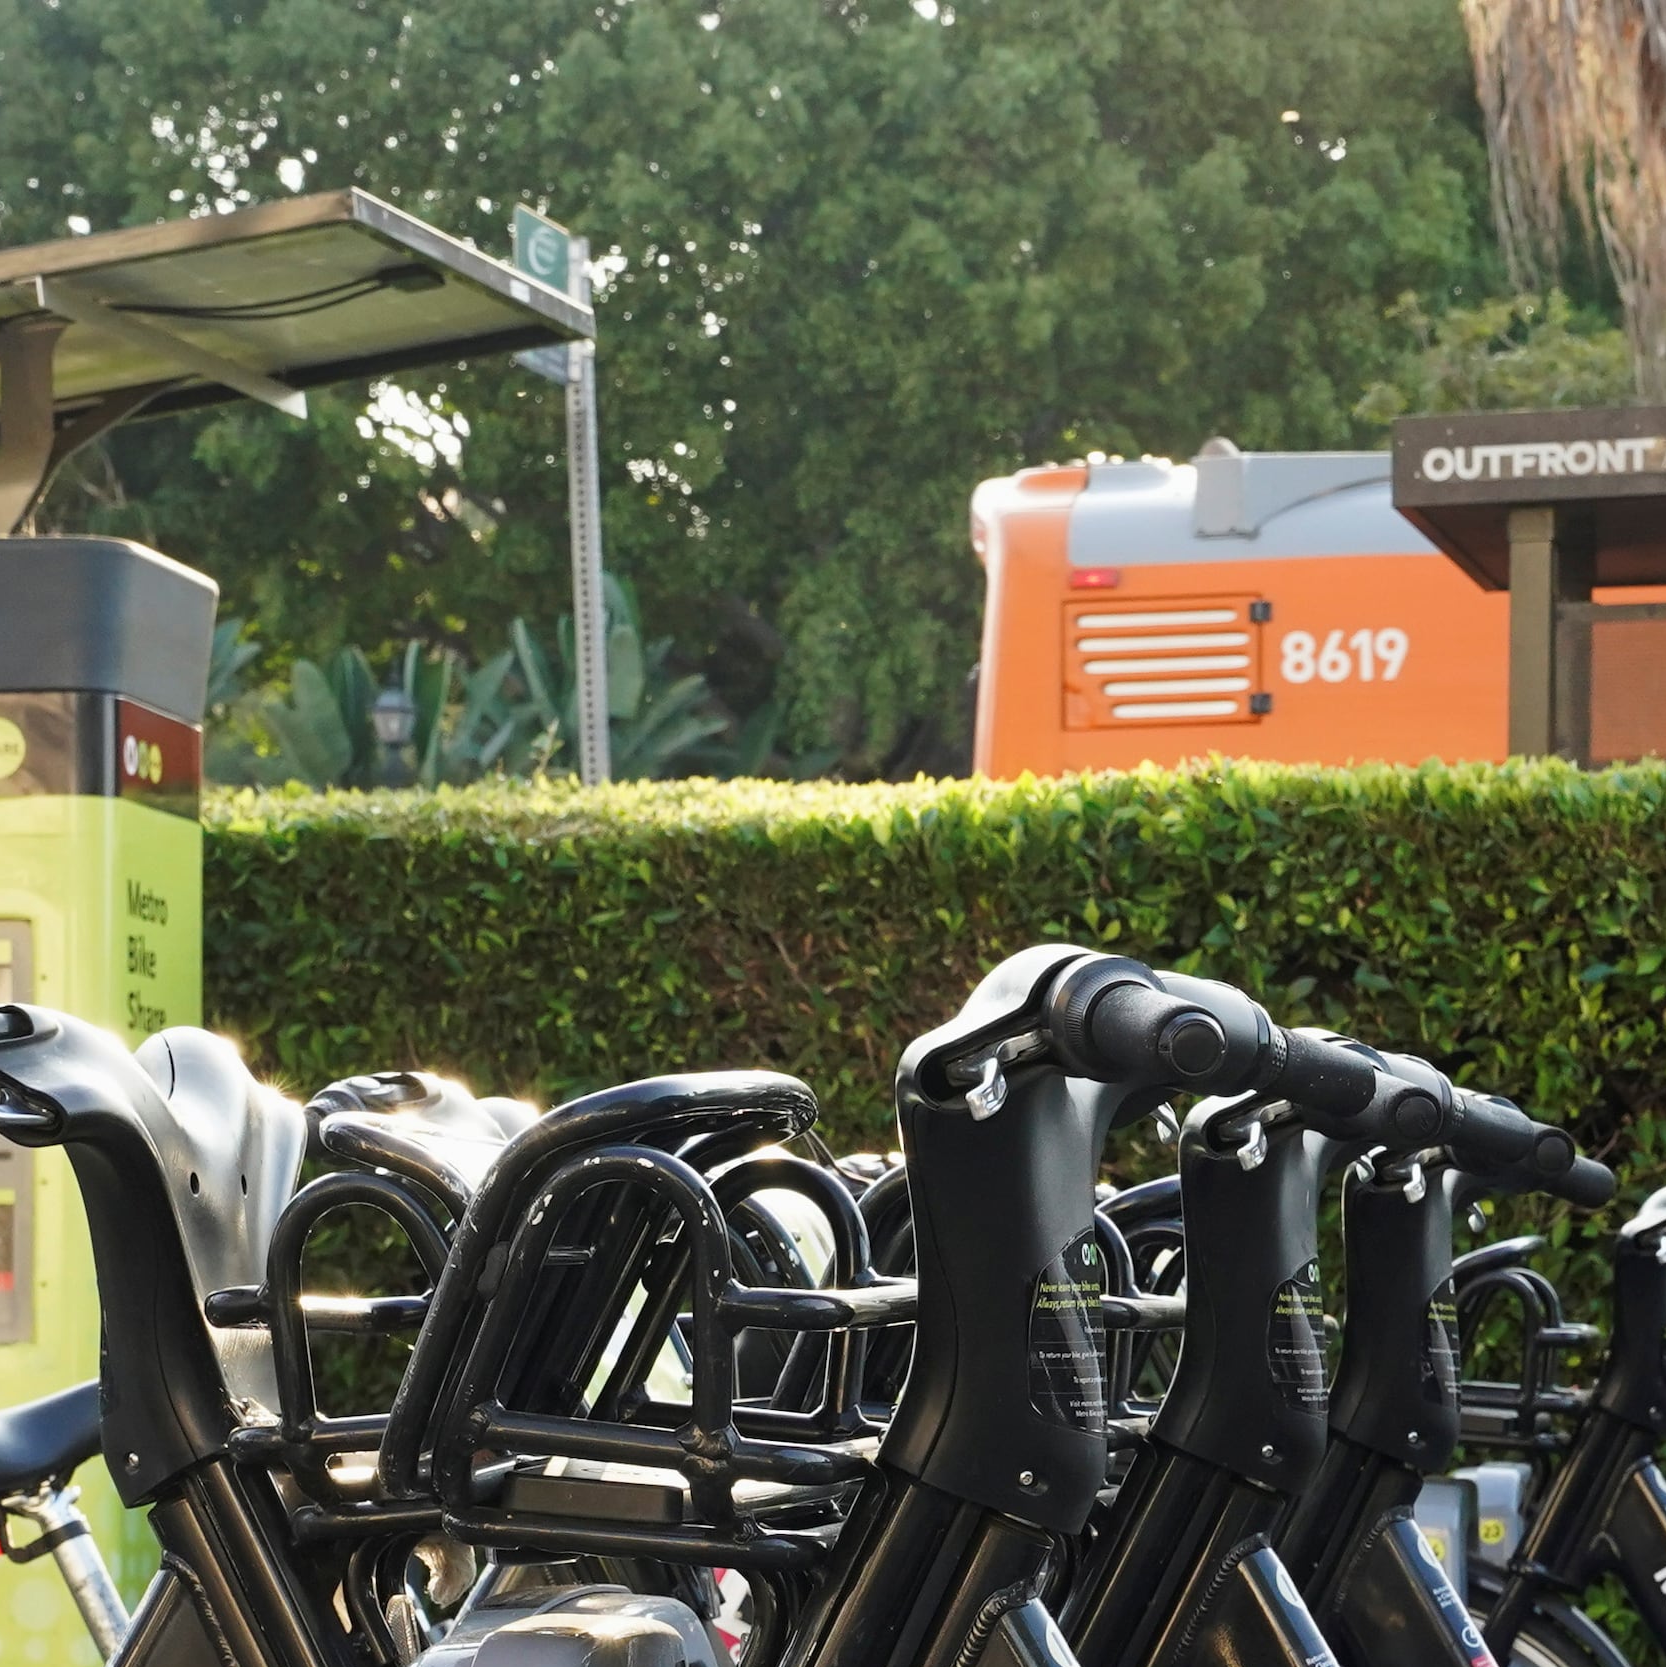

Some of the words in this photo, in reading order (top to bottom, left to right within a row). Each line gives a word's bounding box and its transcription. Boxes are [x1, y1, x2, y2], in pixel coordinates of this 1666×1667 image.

[1422, 438, 1655, 482] OUTFRONT
[1280, 627, 1409, 683] 8619
[127, 879, 169, 926] Metro
[127, 935, 158, 980] Bike
[128, 990, 167, 1034] Share
